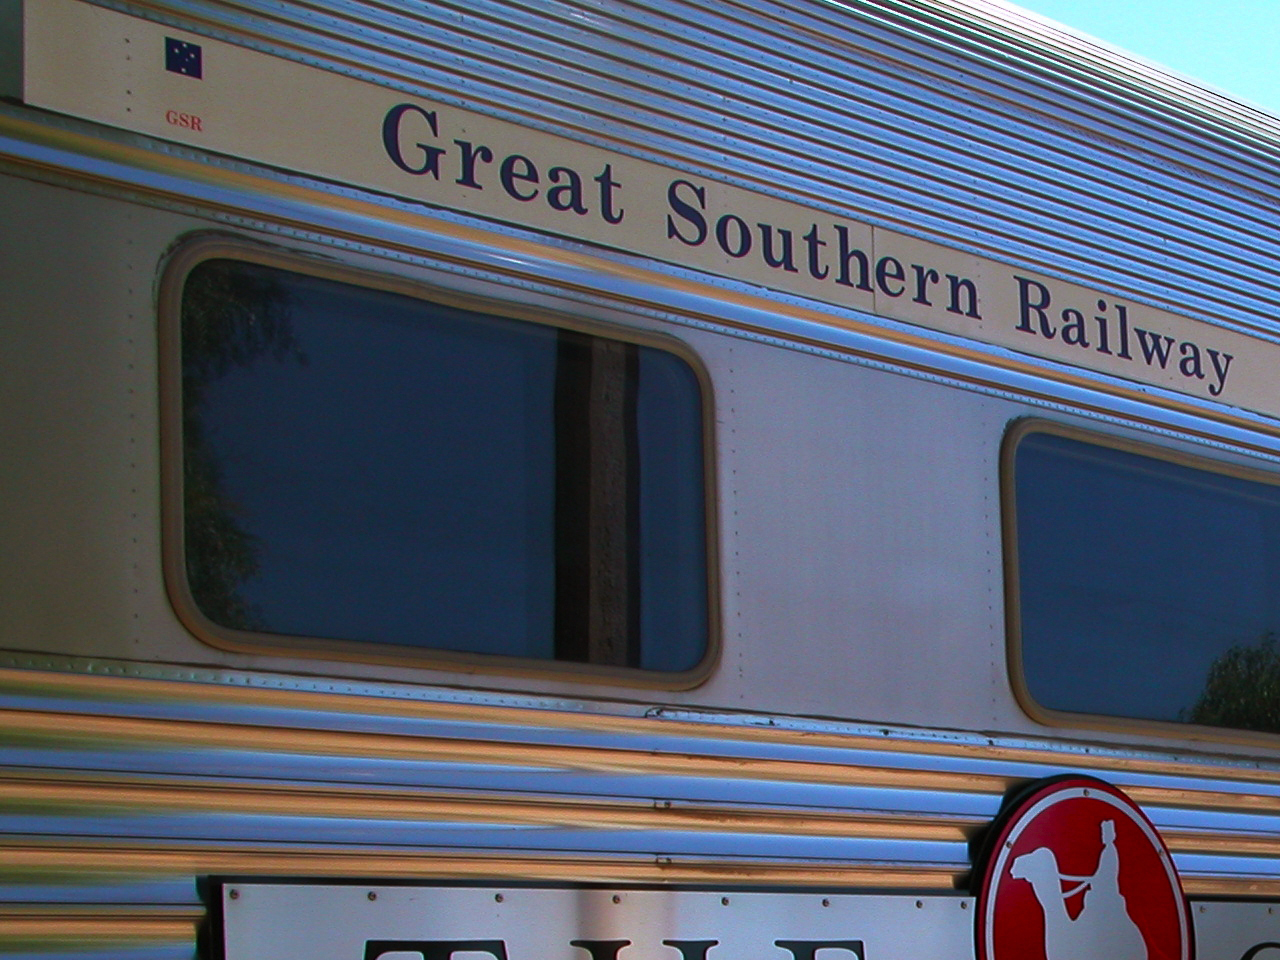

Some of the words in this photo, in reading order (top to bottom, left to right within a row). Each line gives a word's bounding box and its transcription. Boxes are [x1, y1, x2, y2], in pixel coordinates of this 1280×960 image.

[165, 109, 203, 132] GSR
[382, 102, 625, 225] Great
[666, 179, 983, 320] Southern
[1012, 275, 1234, 397] Railway
